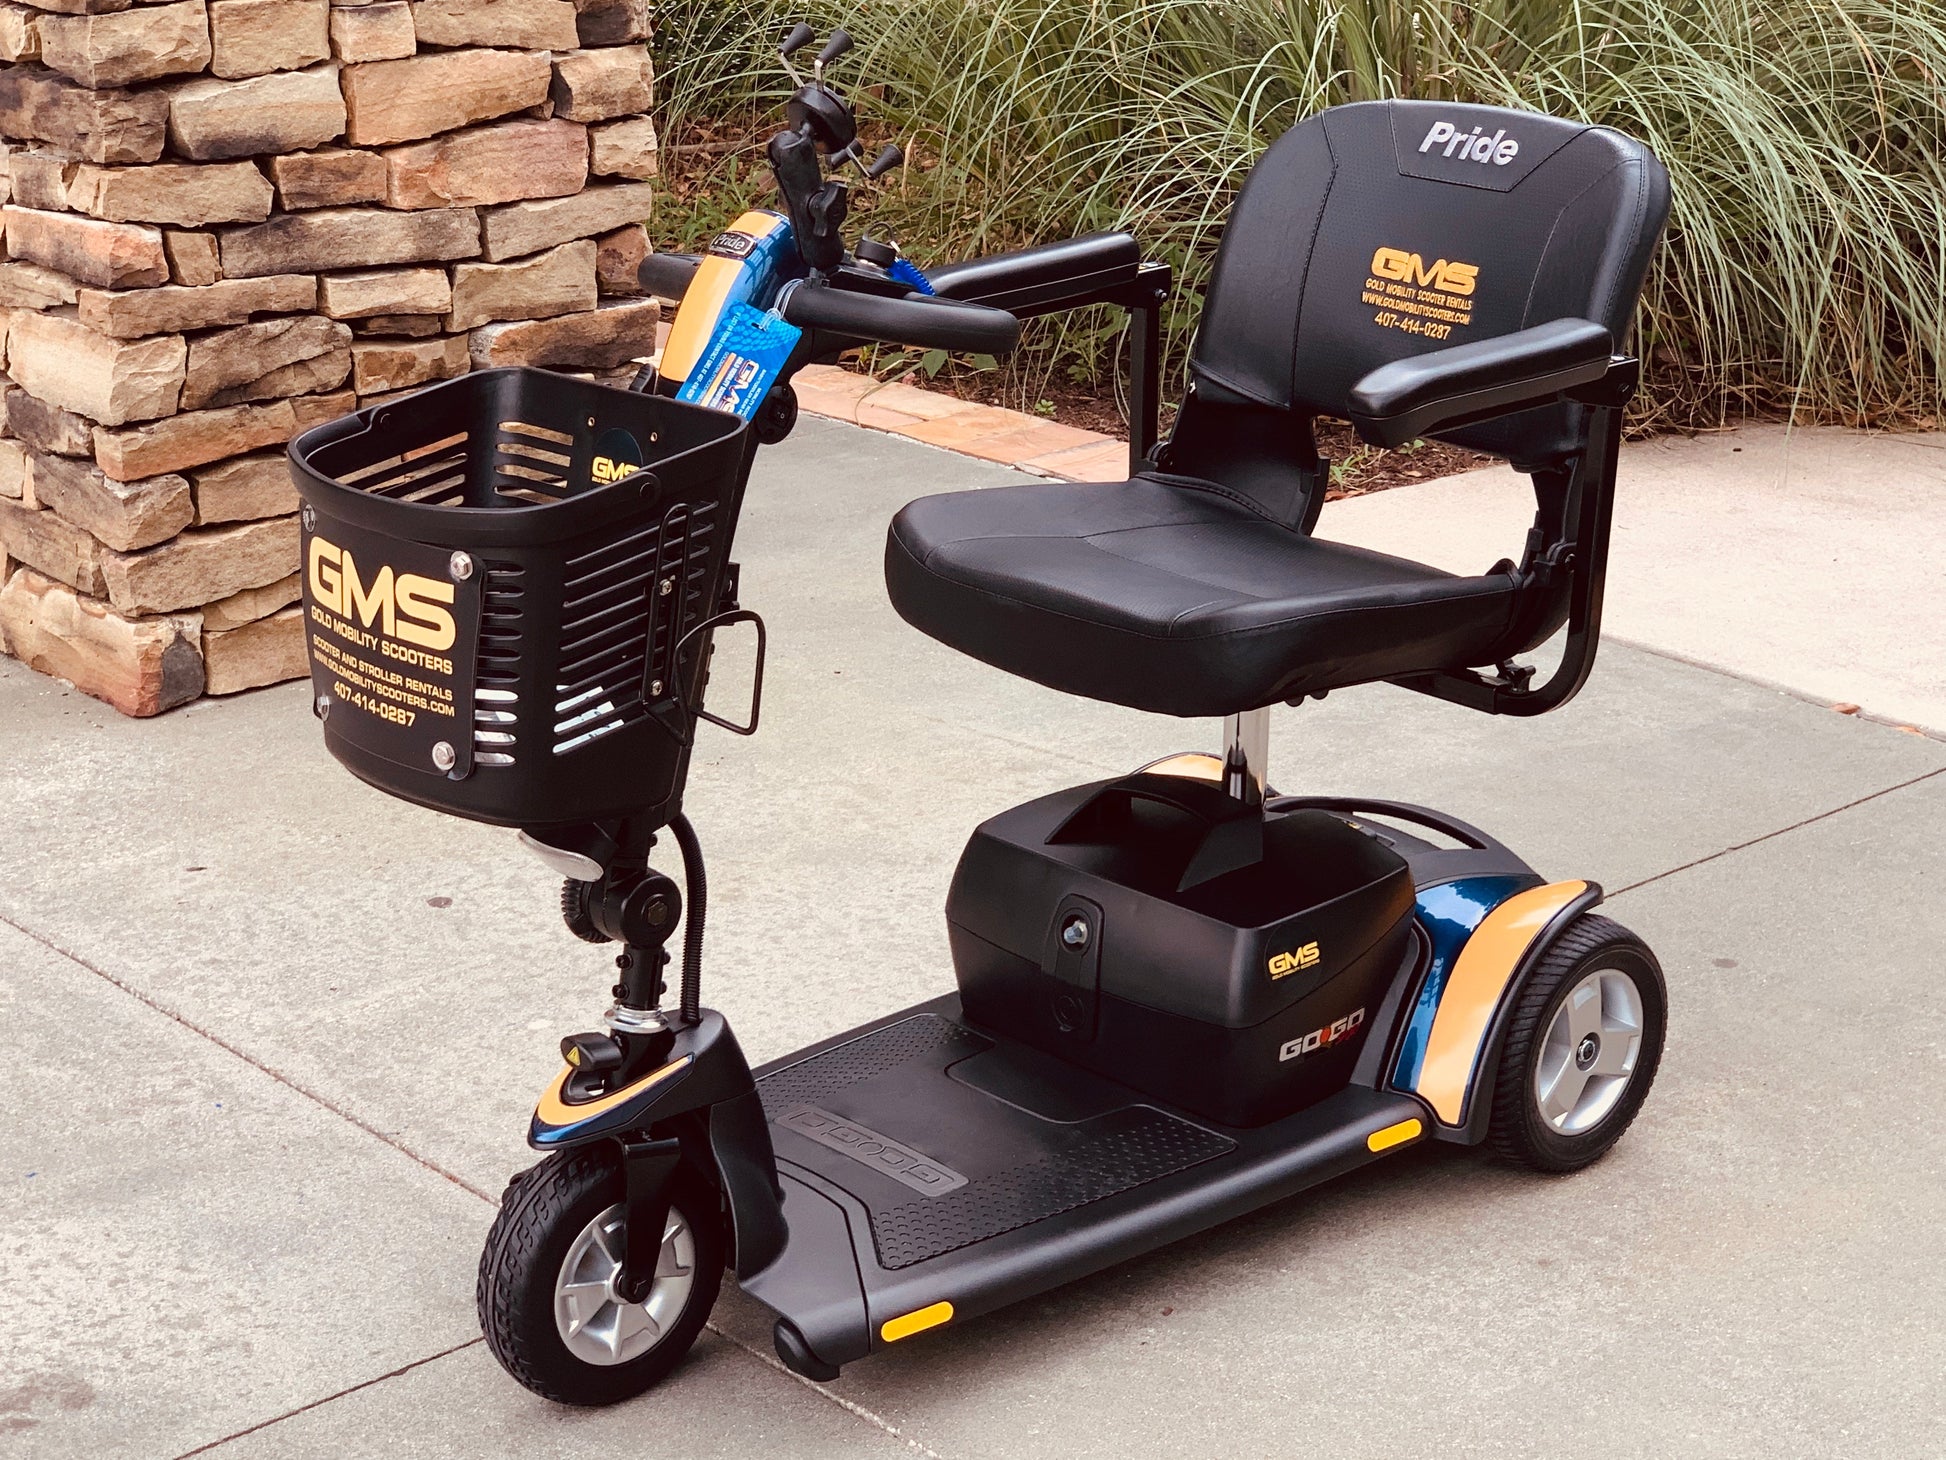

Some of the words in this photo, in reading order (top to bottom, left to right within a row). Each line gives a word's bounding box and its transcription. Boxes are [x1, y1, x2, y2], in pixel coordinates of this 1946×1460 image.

[1418, 121, 1519, 166] Pride
[713, 234, 745, 250] Pride
[1365, 278, 1384, 292] GOLD
[1386, 283, 1416, 299] MOBILITY
[1418, 290, 1445, 307] SCOOTER
[1447, 296, 1472, 310] RENTALS
[1371, 246, 1480, 296] GMS
[1374, 311, 1451, 340] 407-414-0287
[309, 536, 456, 651] GMS
[311, 605, 332, 630] GOLD
[333, 615, 379, 651] MOBILITY
[381, 640, 453, 675] SCOOTERS
[313, 634, 341, 660] SCOOTER
[341, 652, 357, 668] AND
[358, 657, 403, 687] STROLLER
[405, 675, 453, 702] RENTALS
[313, 648, 455, 717] WWW.GOLDMOBILITYSCOOTERS.COM
[1268, 941, 1320, 975] GMS
